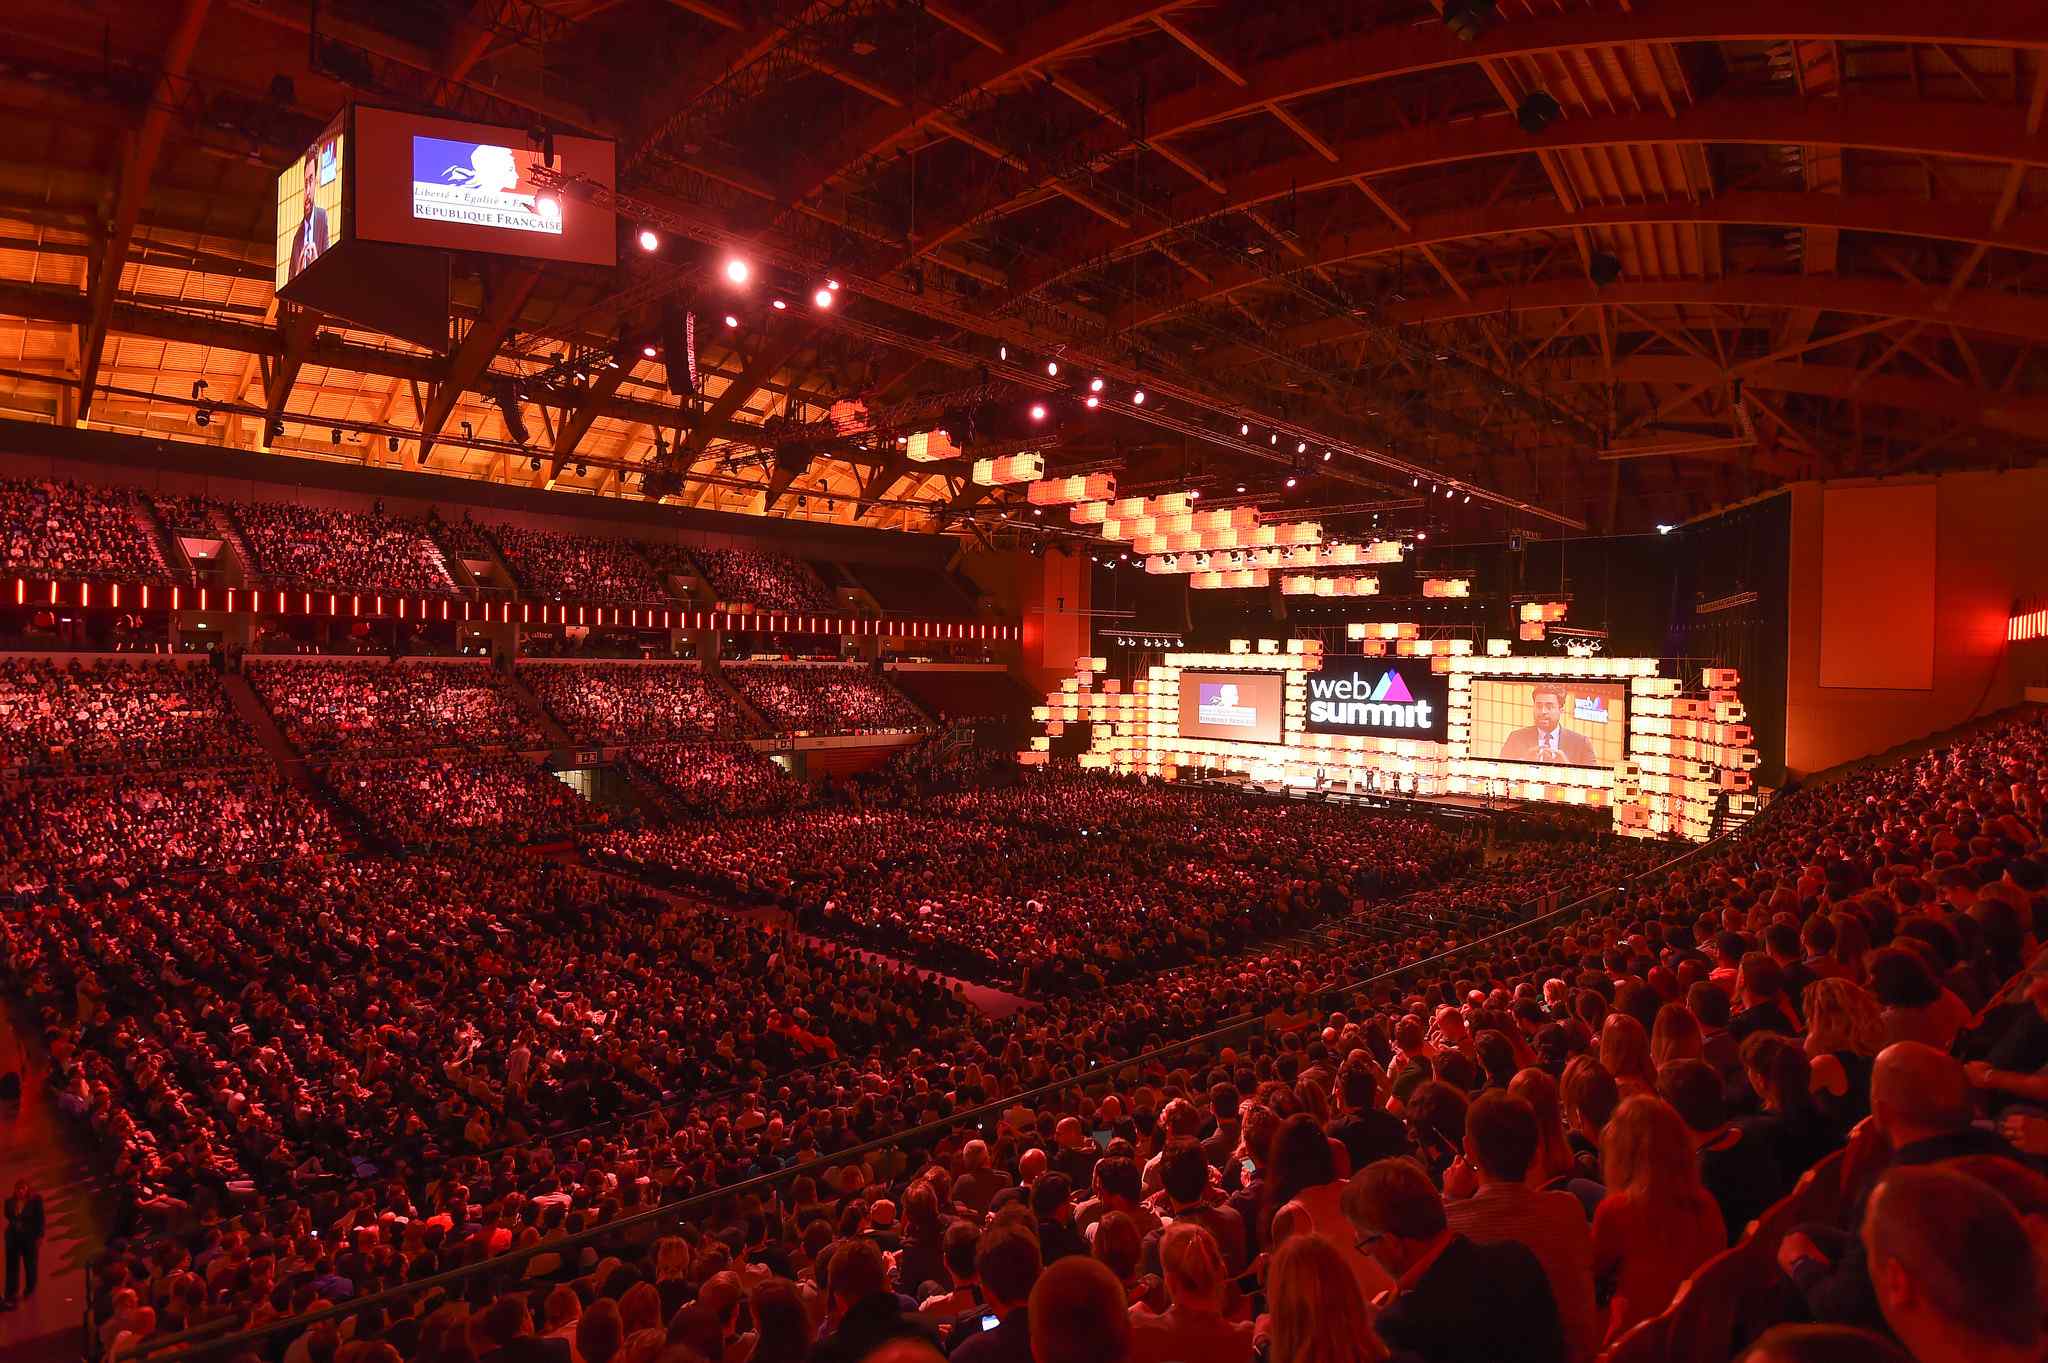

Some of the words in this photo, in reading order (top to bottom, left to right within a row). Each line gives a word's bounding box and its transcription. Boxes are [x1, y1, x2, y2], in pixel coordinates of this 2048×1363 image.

[414, 186, 451, 200] Liberté
[415, 204, 493, 223] RÉPUBLIQUE
[1310, 671, 1371, 700] web
[1310, 700, 1432, 729] summit
